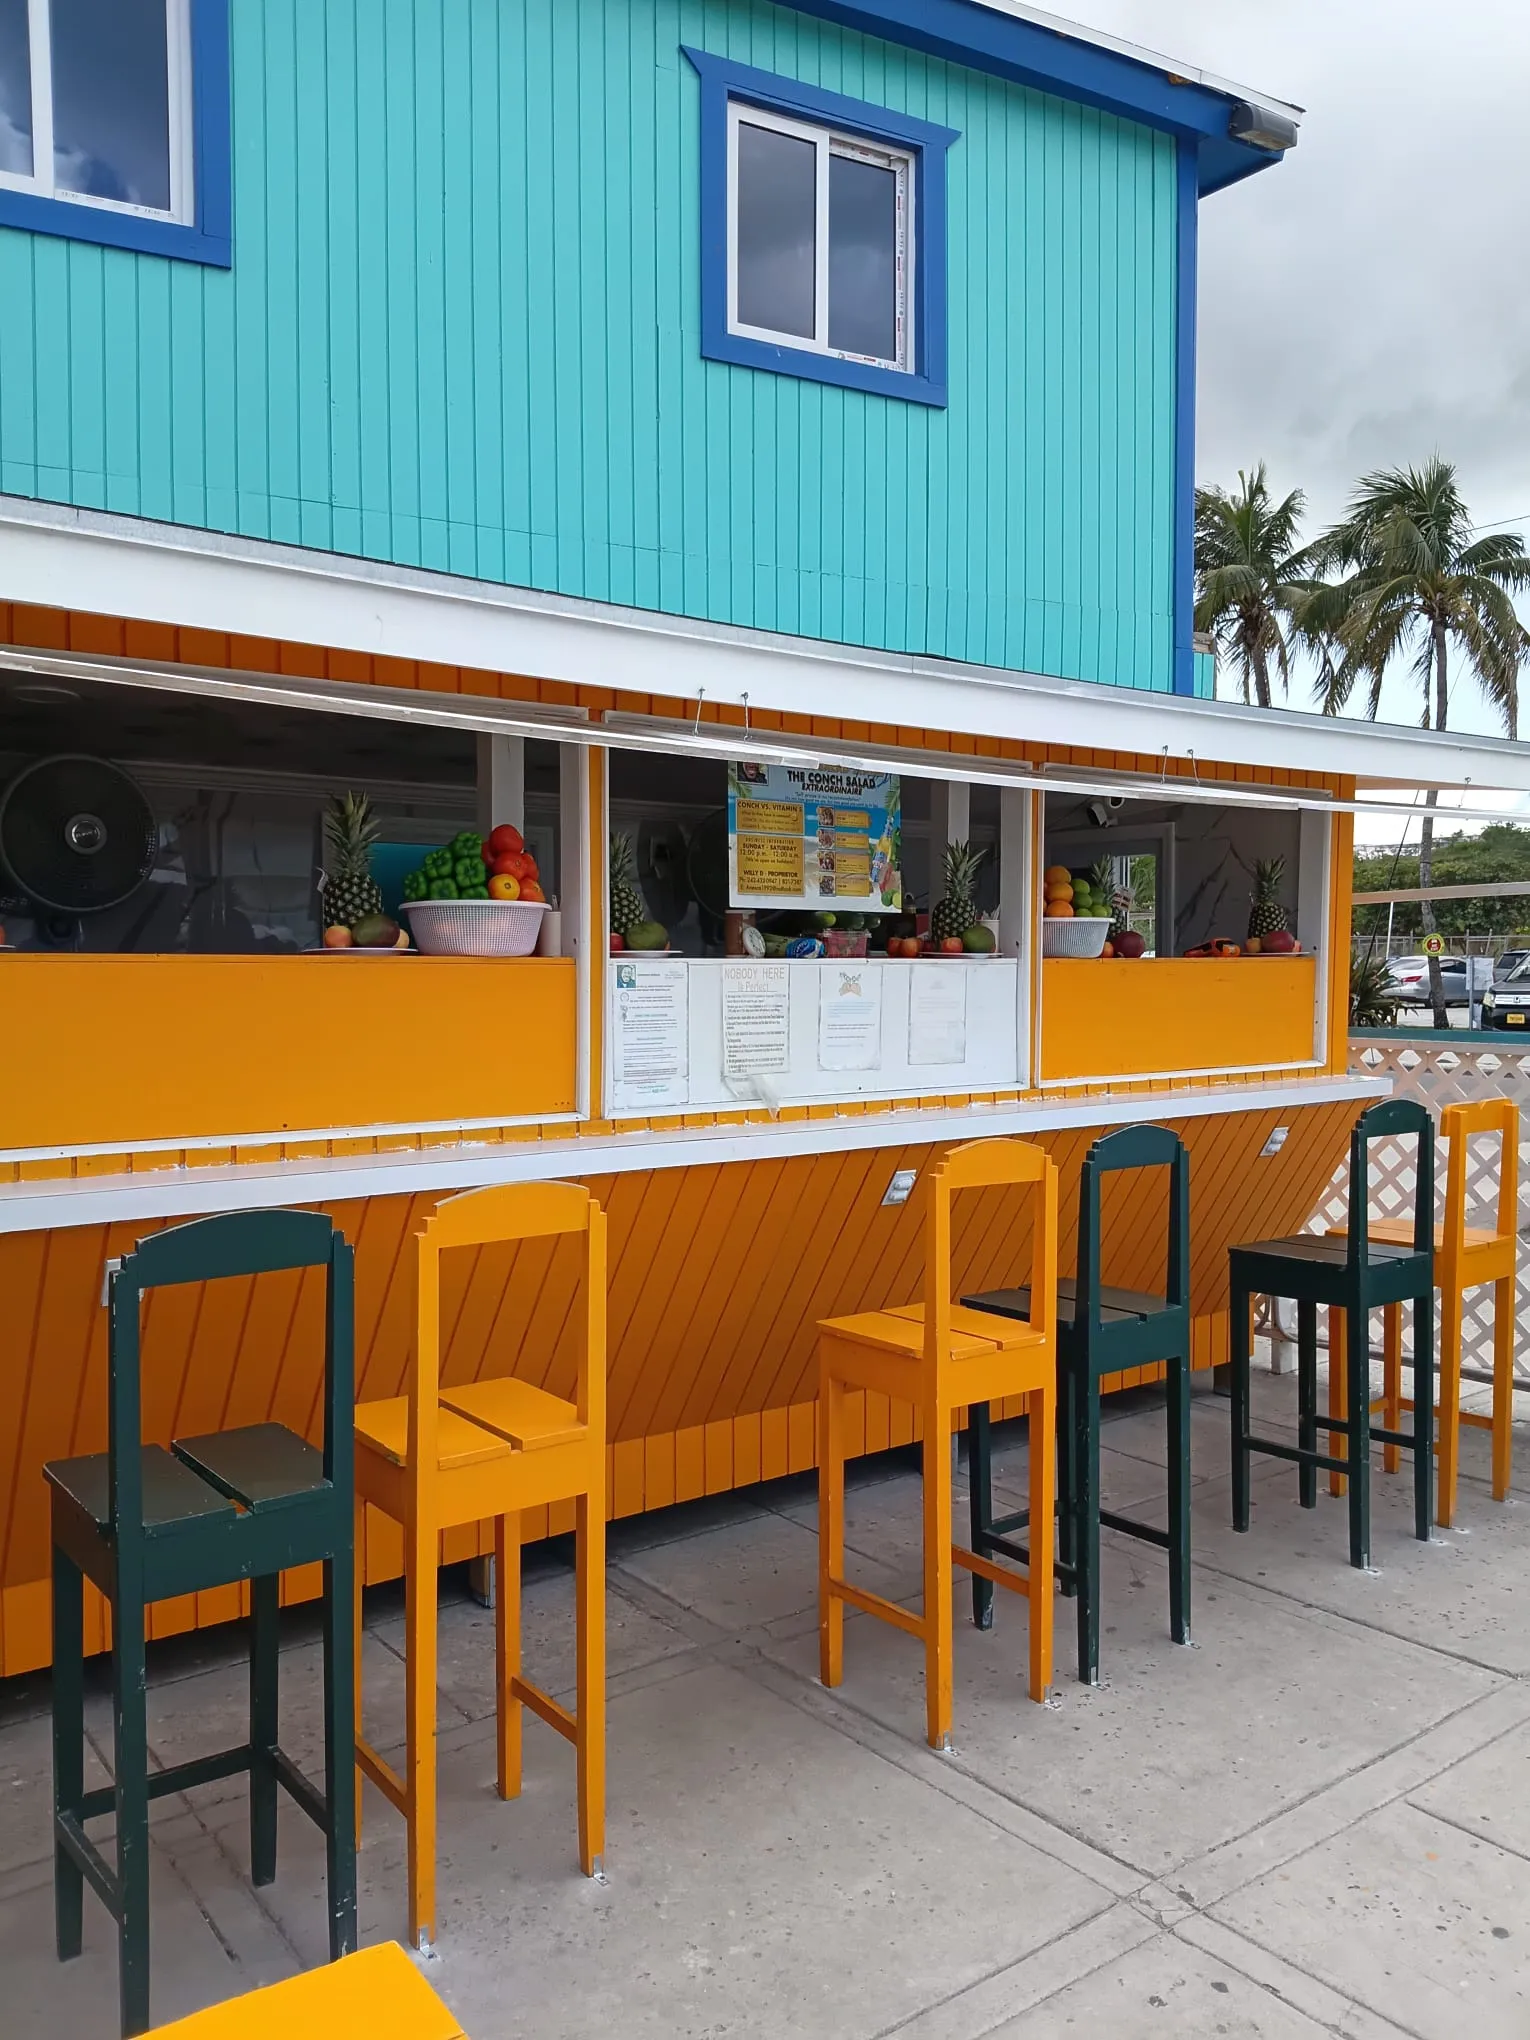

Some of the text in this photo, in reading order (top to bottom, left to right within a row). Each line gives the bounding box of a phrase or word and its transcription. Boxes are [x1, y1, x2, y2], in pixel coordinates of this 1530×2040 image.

[787, 770, 876, 789] THE CONCH SALAD
[802, 783, 862, 795] EXTRAORDINAIRE
[724, 967, 784, 980] NOBODY HERE
